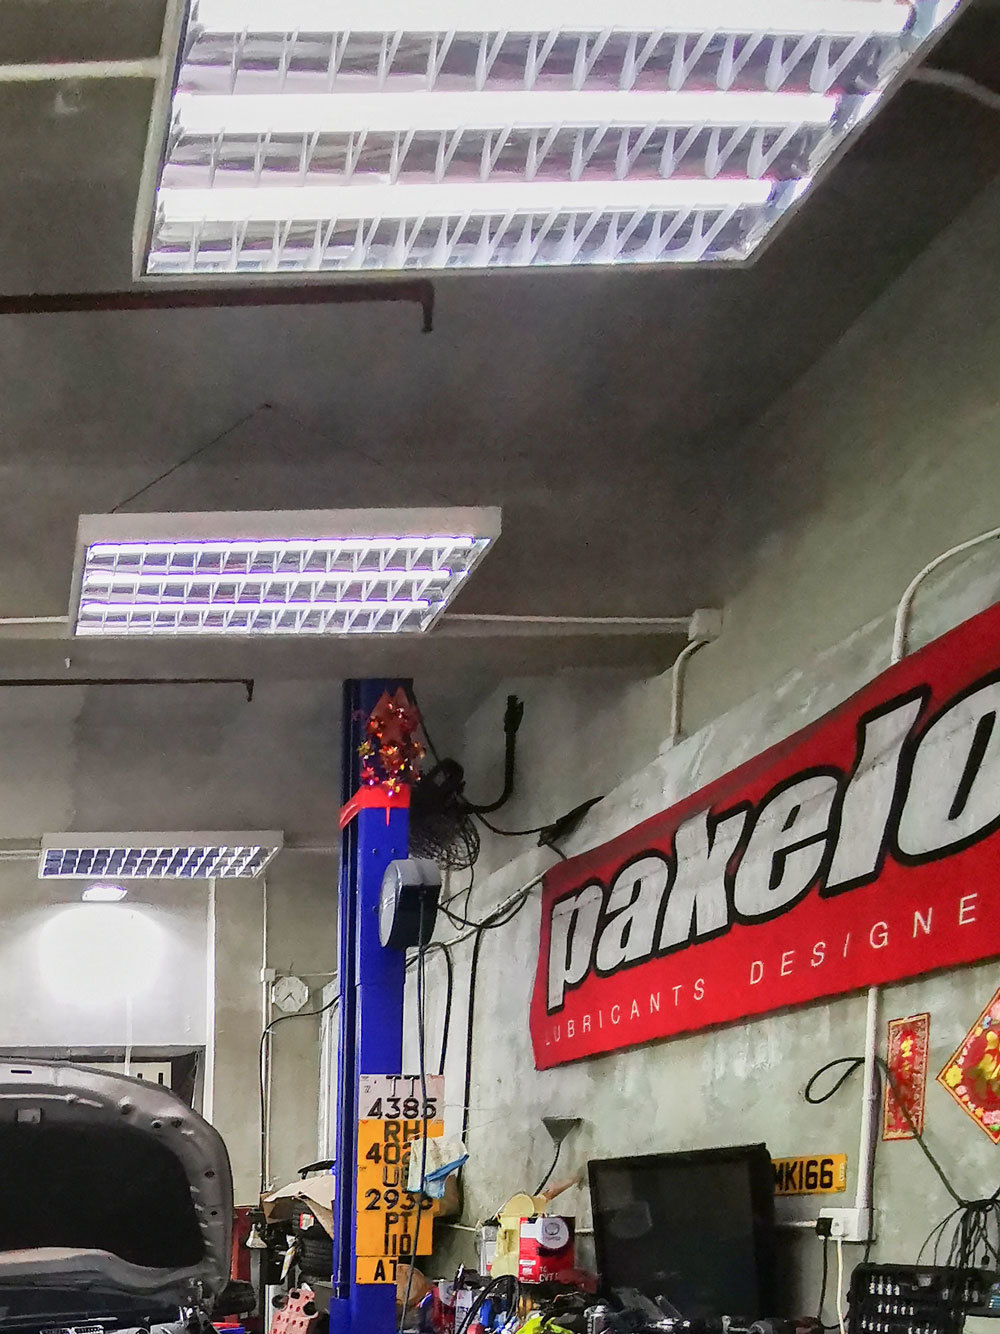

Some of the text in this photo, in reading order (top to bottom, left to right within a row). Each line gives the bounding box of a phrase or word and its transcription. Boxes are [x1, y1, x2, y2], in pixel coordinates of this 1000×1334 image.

[545, 665, 1000, 1015] pakelo
[385, 1074, 420, 1098] TT
[383, 1120, 421, 1142] RH
[385, 1212, 412, 1234] PT
[384, 1233, 411, 1255] 110
